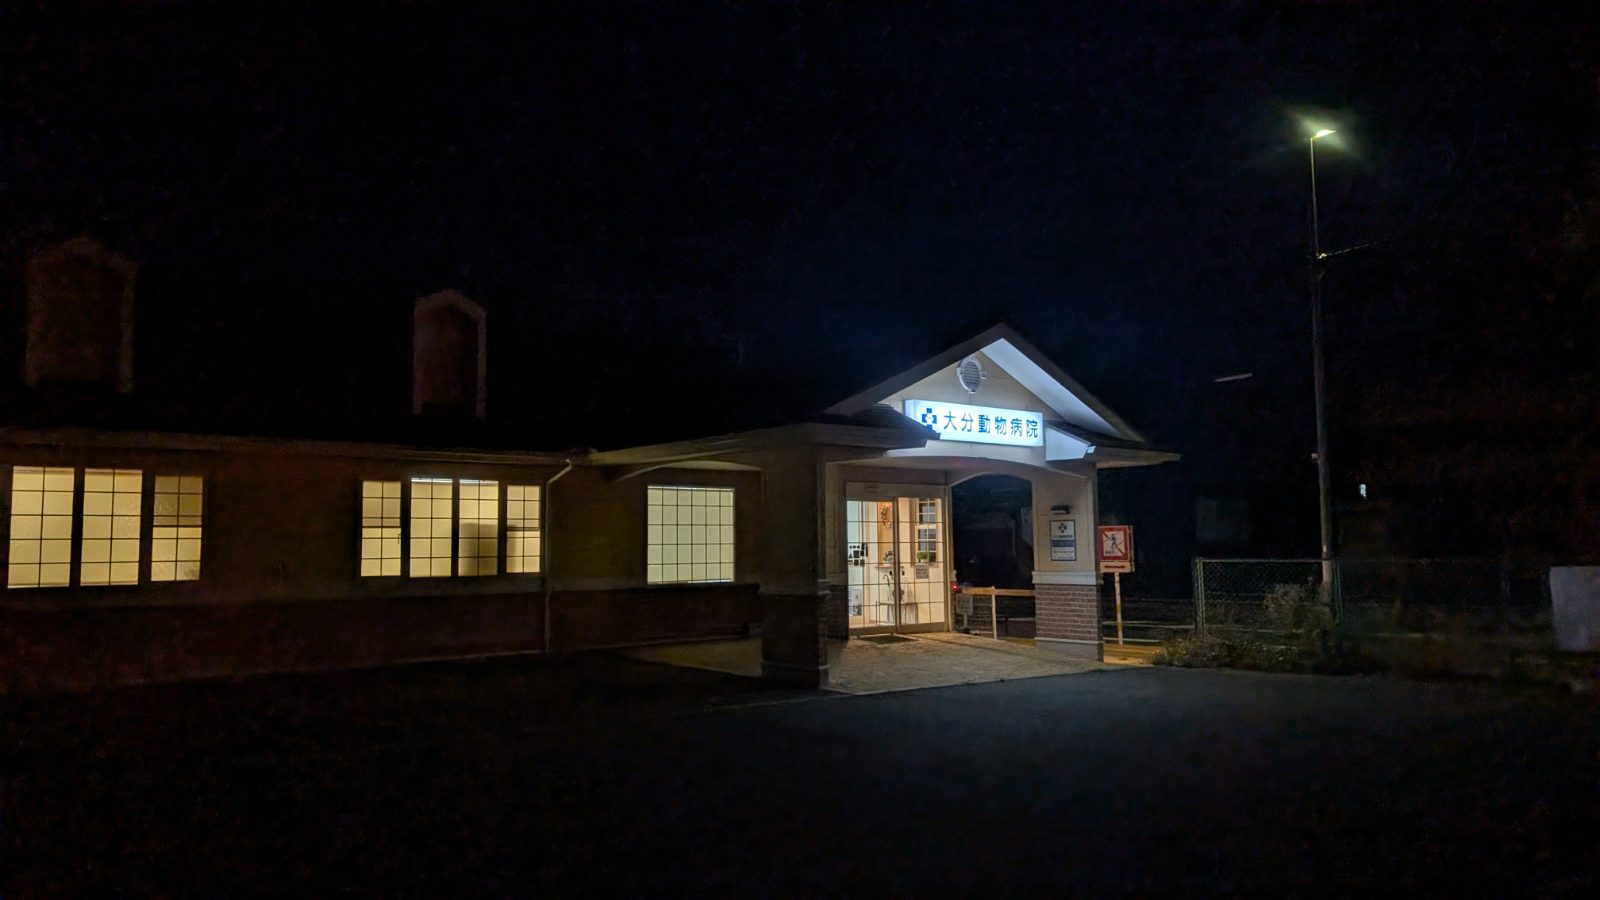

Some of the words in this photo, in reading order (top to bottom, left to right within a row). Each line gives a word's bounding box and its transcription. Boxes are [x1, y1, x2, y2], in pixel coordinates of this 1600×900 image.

[944, 411, 1038, 438] 大分動物病院
